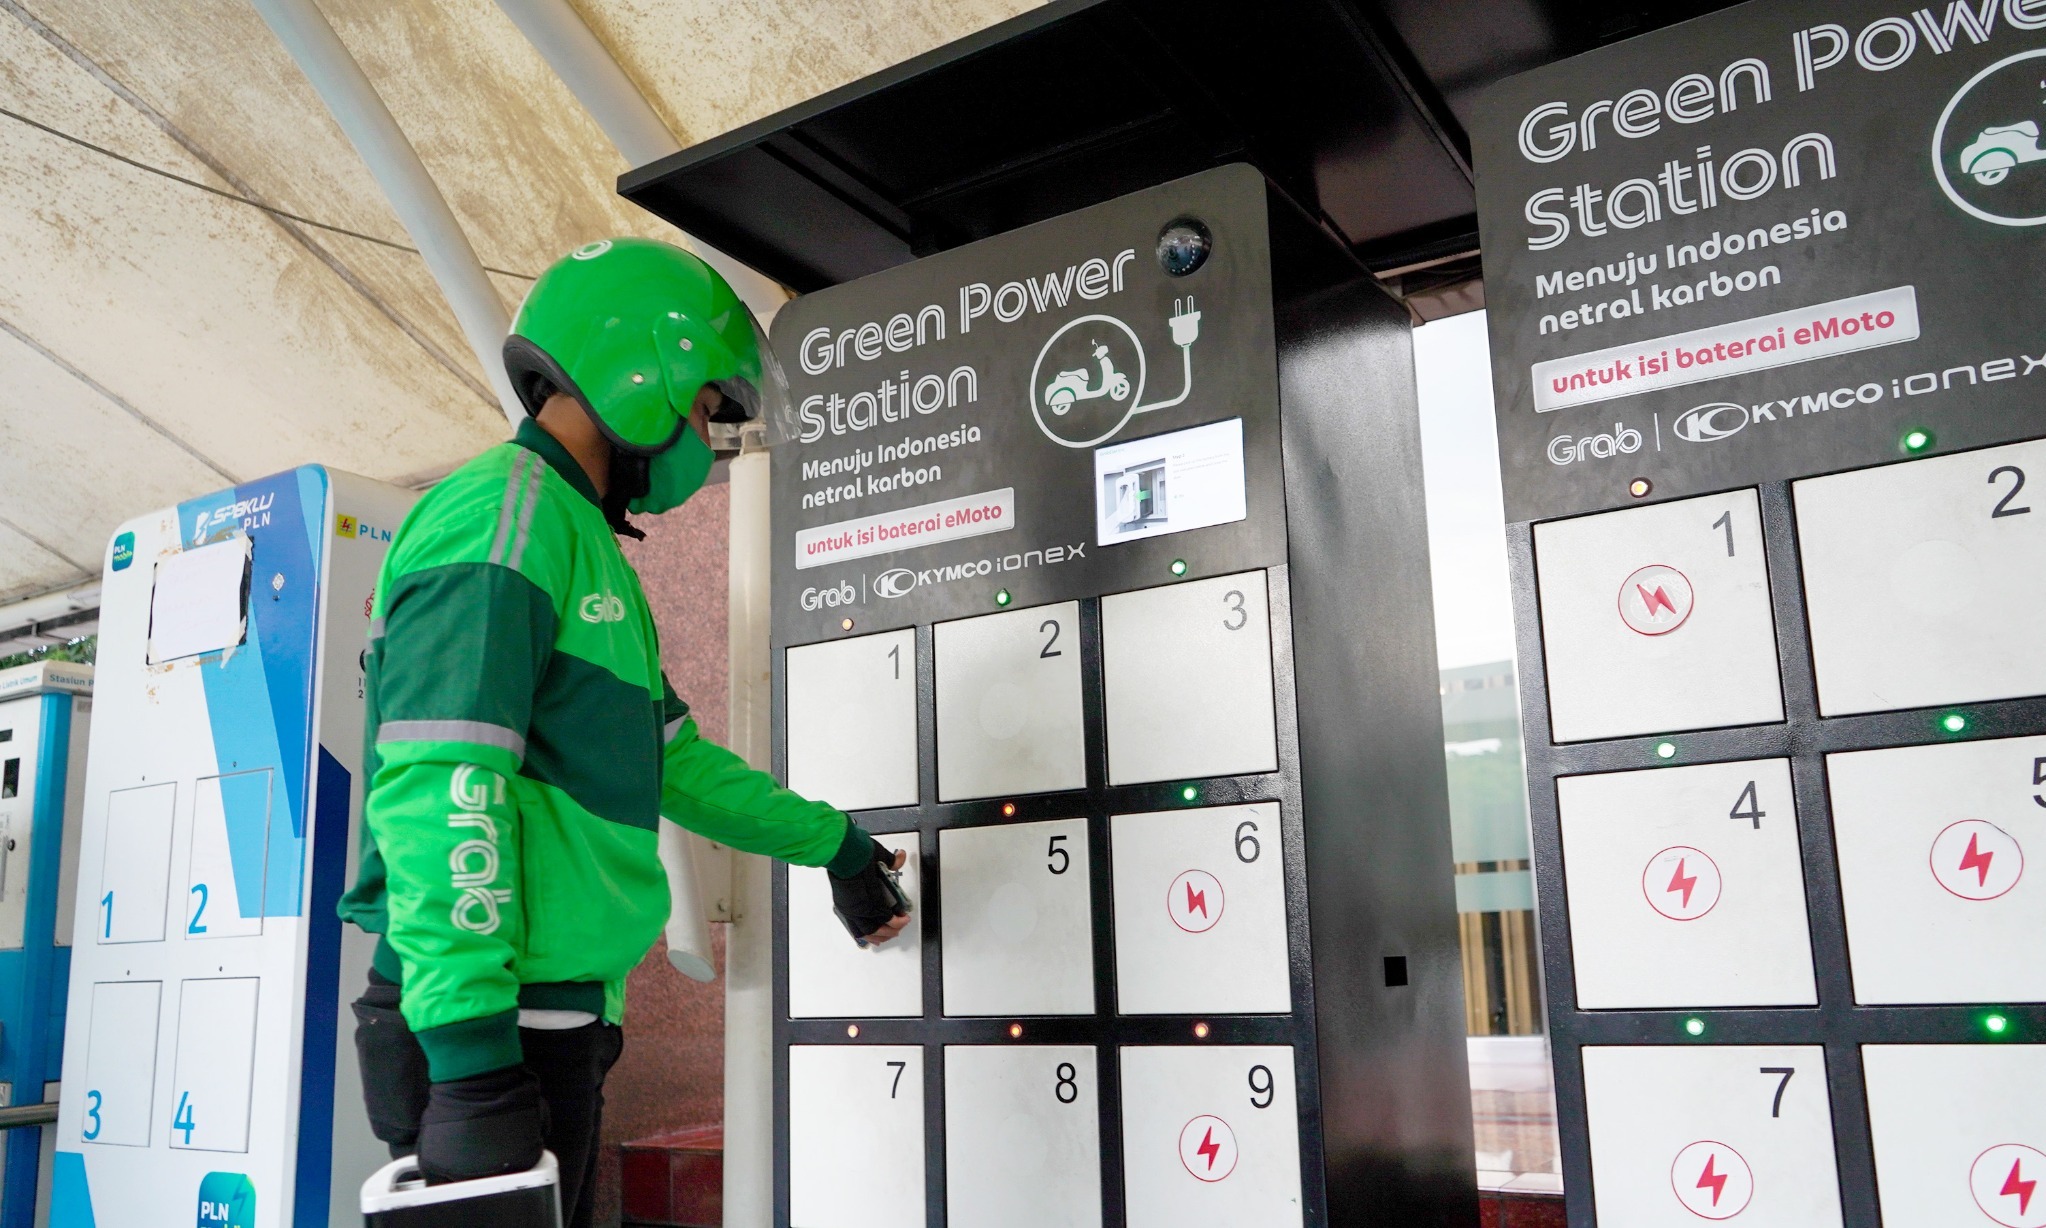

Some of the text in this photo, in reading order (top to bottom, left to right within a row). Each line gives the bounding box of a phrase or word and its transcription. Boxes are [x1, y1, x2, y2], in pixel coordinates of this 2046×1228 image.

[1517, 57, 1772, 164] Green
[1524, 132, 1837, 251] Station
[1535, 207, 1848, 299] Menuju Indonesia
[800, 248, 1135, 376] Green Power
[1539, 264, 1782, 336] netral karbon
[1552, 309, 1895, 394] untuk isi baterai eMoto
[799, 364, 978, 444] Station
[1547, 423, 1643, 467] Grab
[1751, 382, 1884, 424] KYMCO
[802, 424, 982, 481] Menuju Indonesia
[801, 464, 942, 510] netral karbon
[1987, 464, 2032, 520] 2
[243, 511, 271, 531] PLN
[358, 524, 392, 542] PLN
[806, 503, 1003, 556] untuk isi baterai eMoto
[1711, 510, 1736, 558] 1
[114, 544, 126, 554] PLN
[800, 580, 856, 612] Grab
[918, 559, 992, 586] KYMCO
[996, 542, 1086, 572] ionex
[1222, 590, 1249, 632] 3
[887, 644, 901, 680] 1
[1038, 619, 1063, 659] 2
[49, 673, 85, 686] Stasiun
[1729, 780, 1767, 830] 4
[448, 762, 513, 935] Grab
[1046, 834, 1070, 876] 5
[1234, 820, 1262, 864] 6
[101, 890, 114, 938] 1
[188, 883, 208, 936] 2
[886, 1061, 906, 1099] 7
[1054, 1062, 1079, 1104] 8
[1247, 1065, 1275, 1109] 9
[1759, 1067, 1796, 1119] 7
[83, 1090, 102, 1141] 3
[173, 1091, 196, 1145] 4
[200, 1201, 229, 1221] PLN
